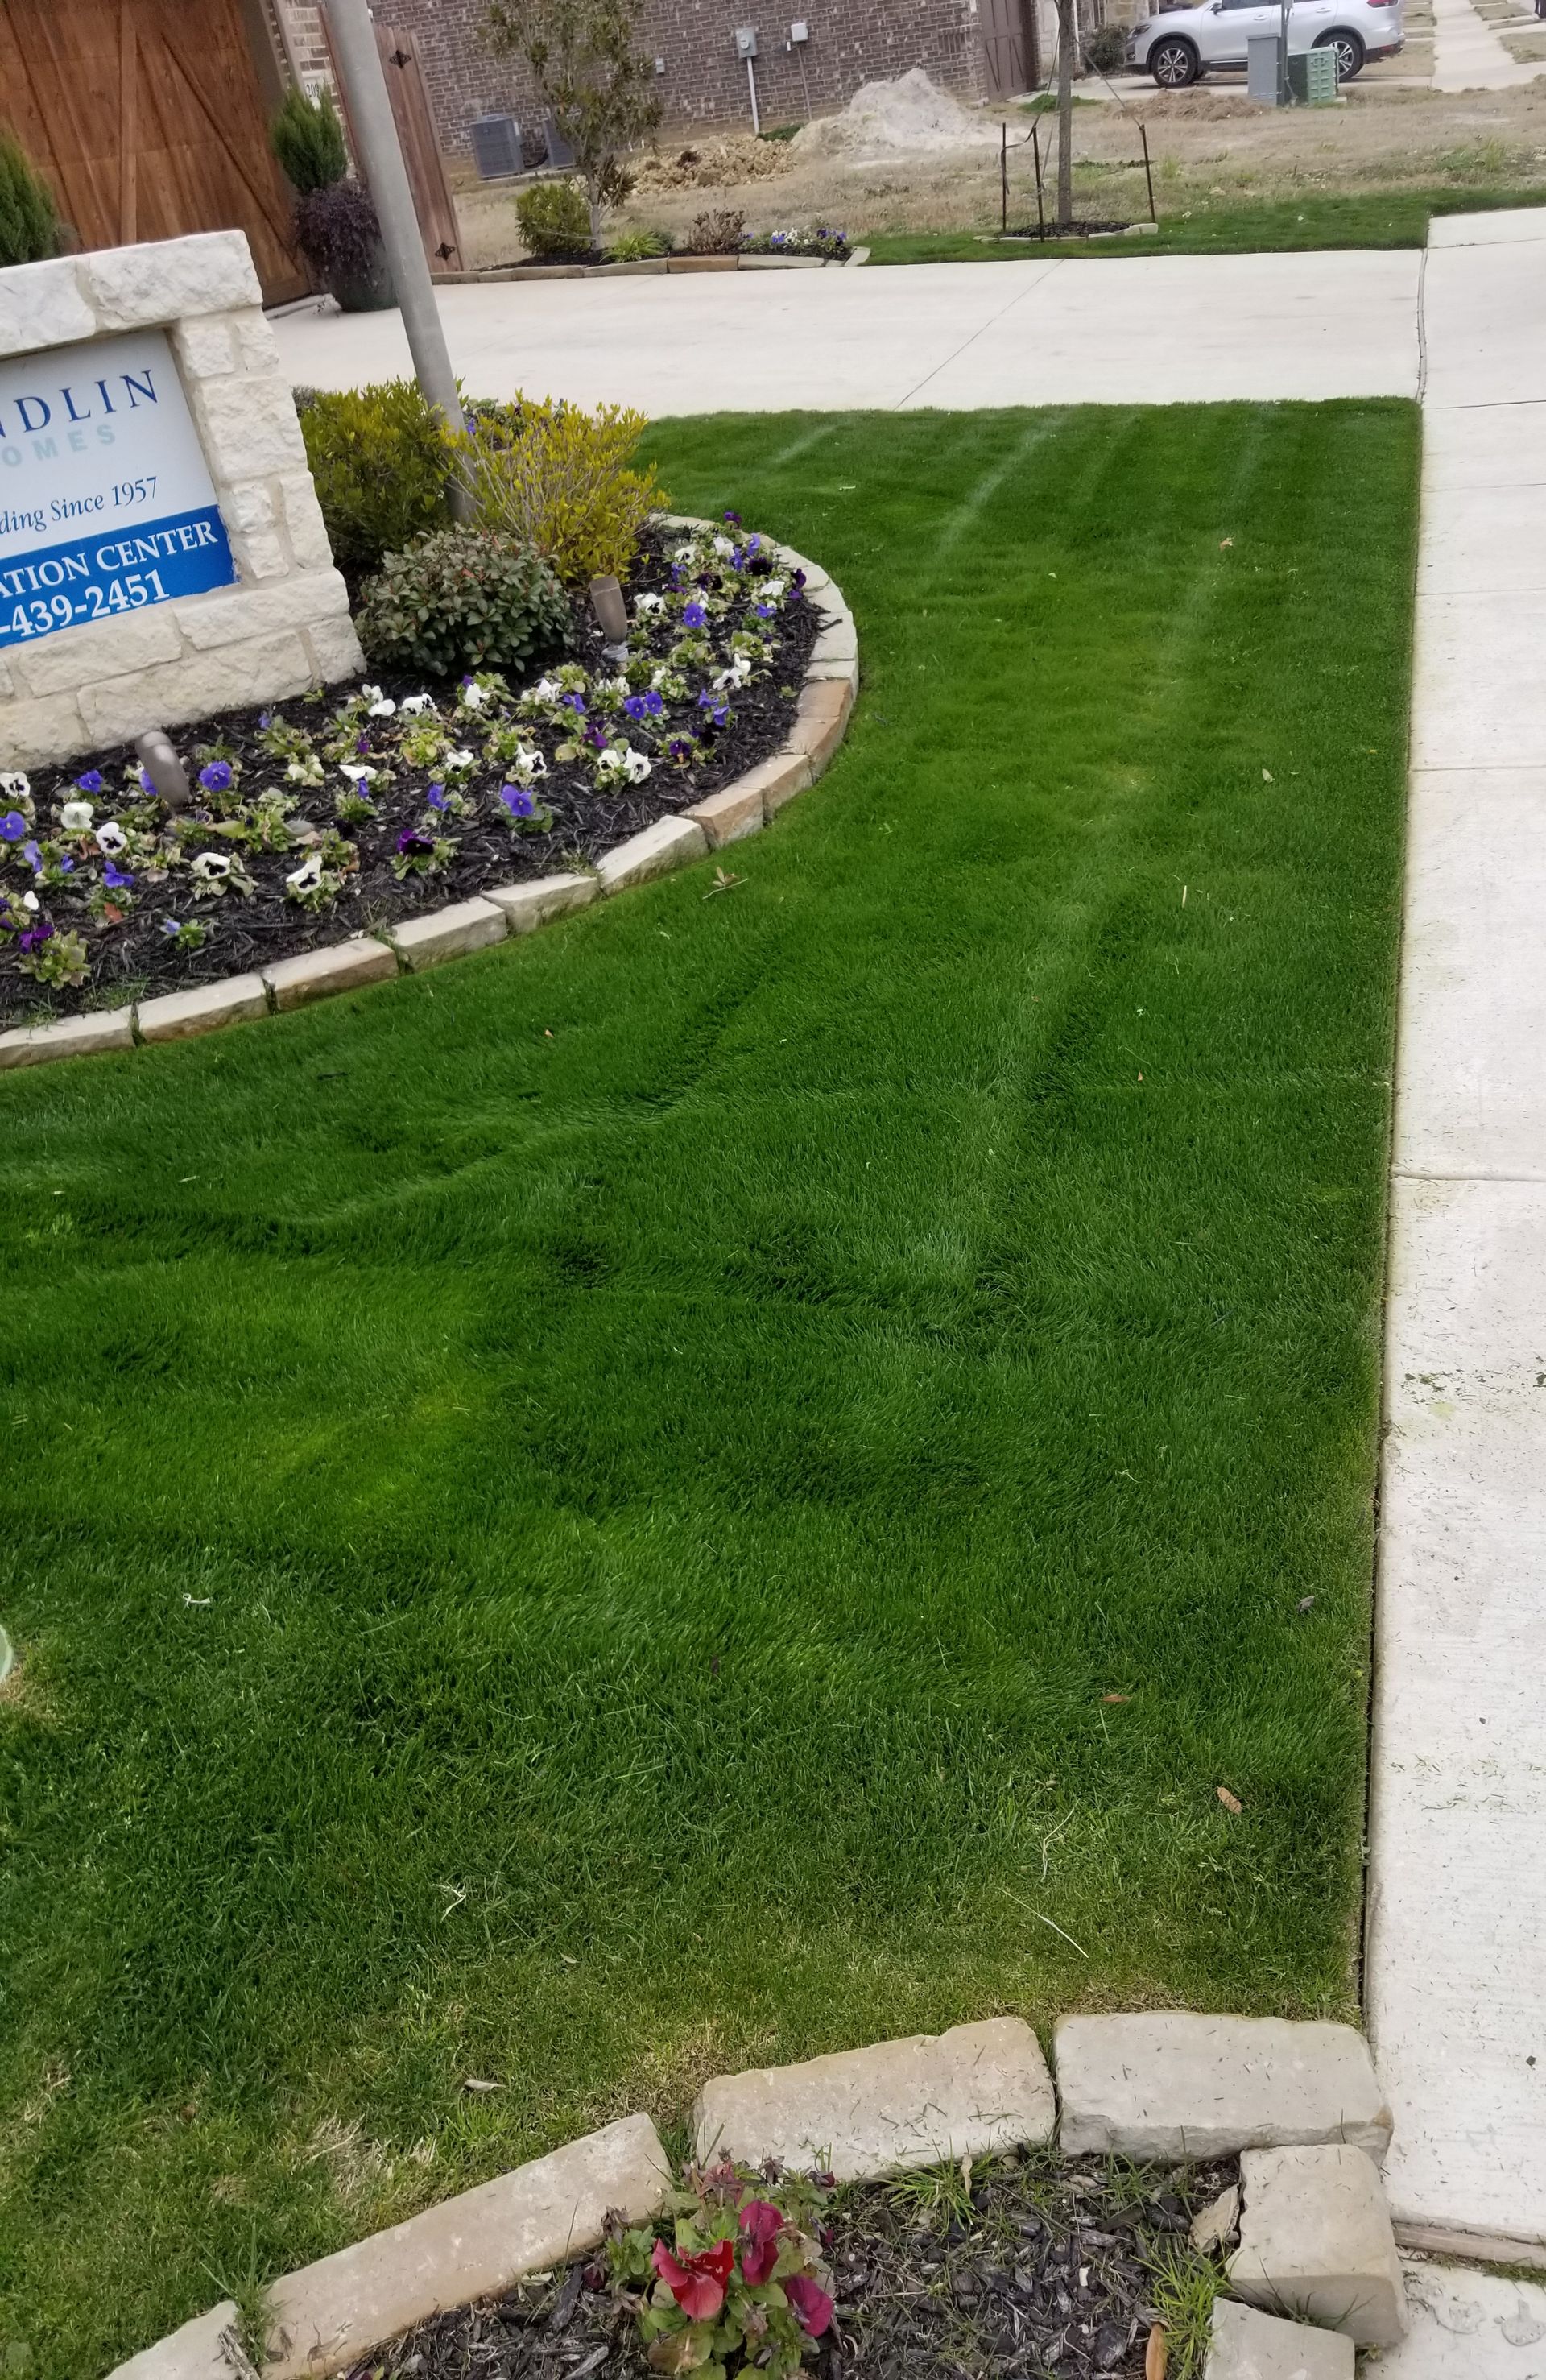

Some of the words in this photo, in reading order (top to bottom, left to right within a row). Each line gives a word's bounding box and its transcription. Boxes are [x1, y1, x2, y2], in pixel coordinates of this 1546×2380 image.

[0, 369, 158, 437] DLIN
[2, 424, 116, 467] OMES
[0, 510, 46, 532] ding
[51, 496, 104, 521] Since
[111, 476, 157, 507] 1957
[96, 521, 218, 571] CENTER
